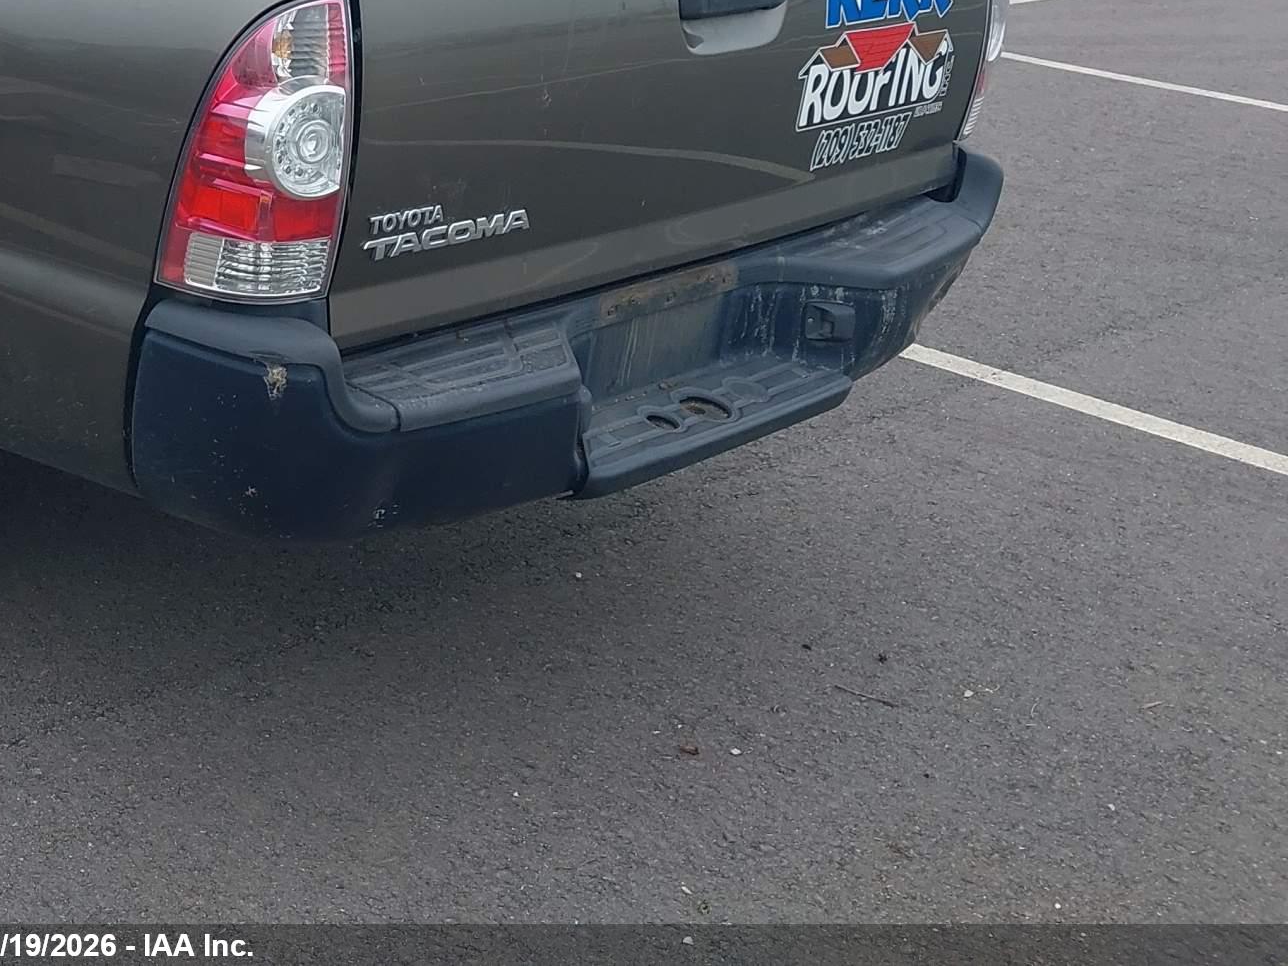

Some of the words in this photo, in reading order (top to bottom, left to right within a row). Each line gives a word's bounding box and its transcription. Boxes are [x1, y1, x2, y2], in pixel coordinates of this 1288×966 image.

[798, 40, 948, 128] ROOFING
[809, 122, 855, 172] (209)
[363, 209, 530, 261] TACOMA
[369, 204, 444, 234] TOYOTA
